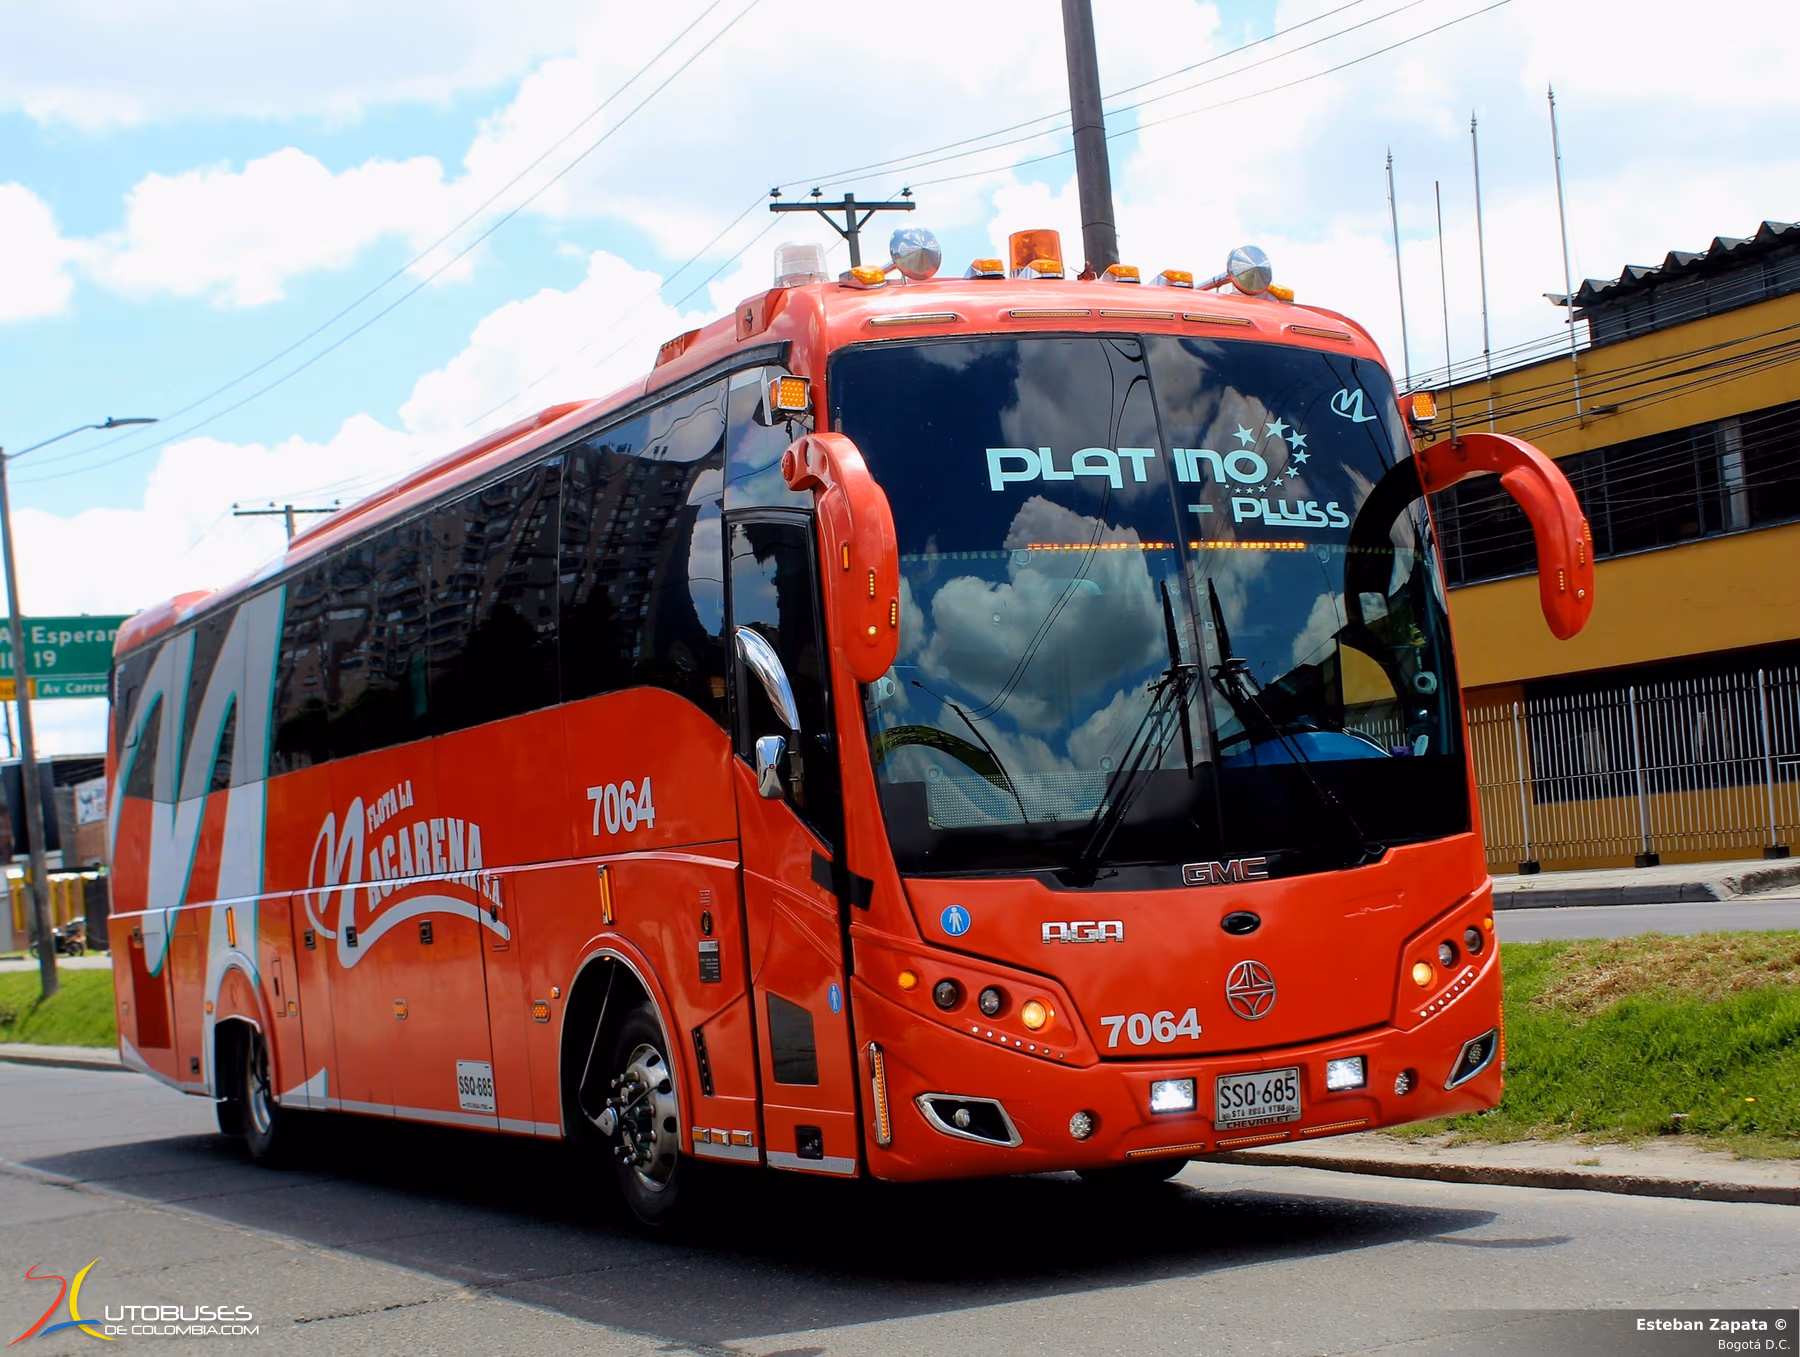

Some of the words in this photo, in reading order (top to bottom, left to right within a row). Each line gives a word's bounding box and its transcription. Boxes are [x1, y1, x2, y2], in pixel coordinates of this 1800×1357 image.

[1231, 497, 1350, 529] PLUSS
[33, 649, 57, 669] 19
[366, 788, 398, 834] FLOTA
[398, 780, 414, 810] LA
[587, 777, 655, 836] 7064
[1182, 857, 1269, 886] GMC
[1100, 1007, 1202, 1048] 7064
[1226, 1115, 1291, 1129] CHEVROLET
